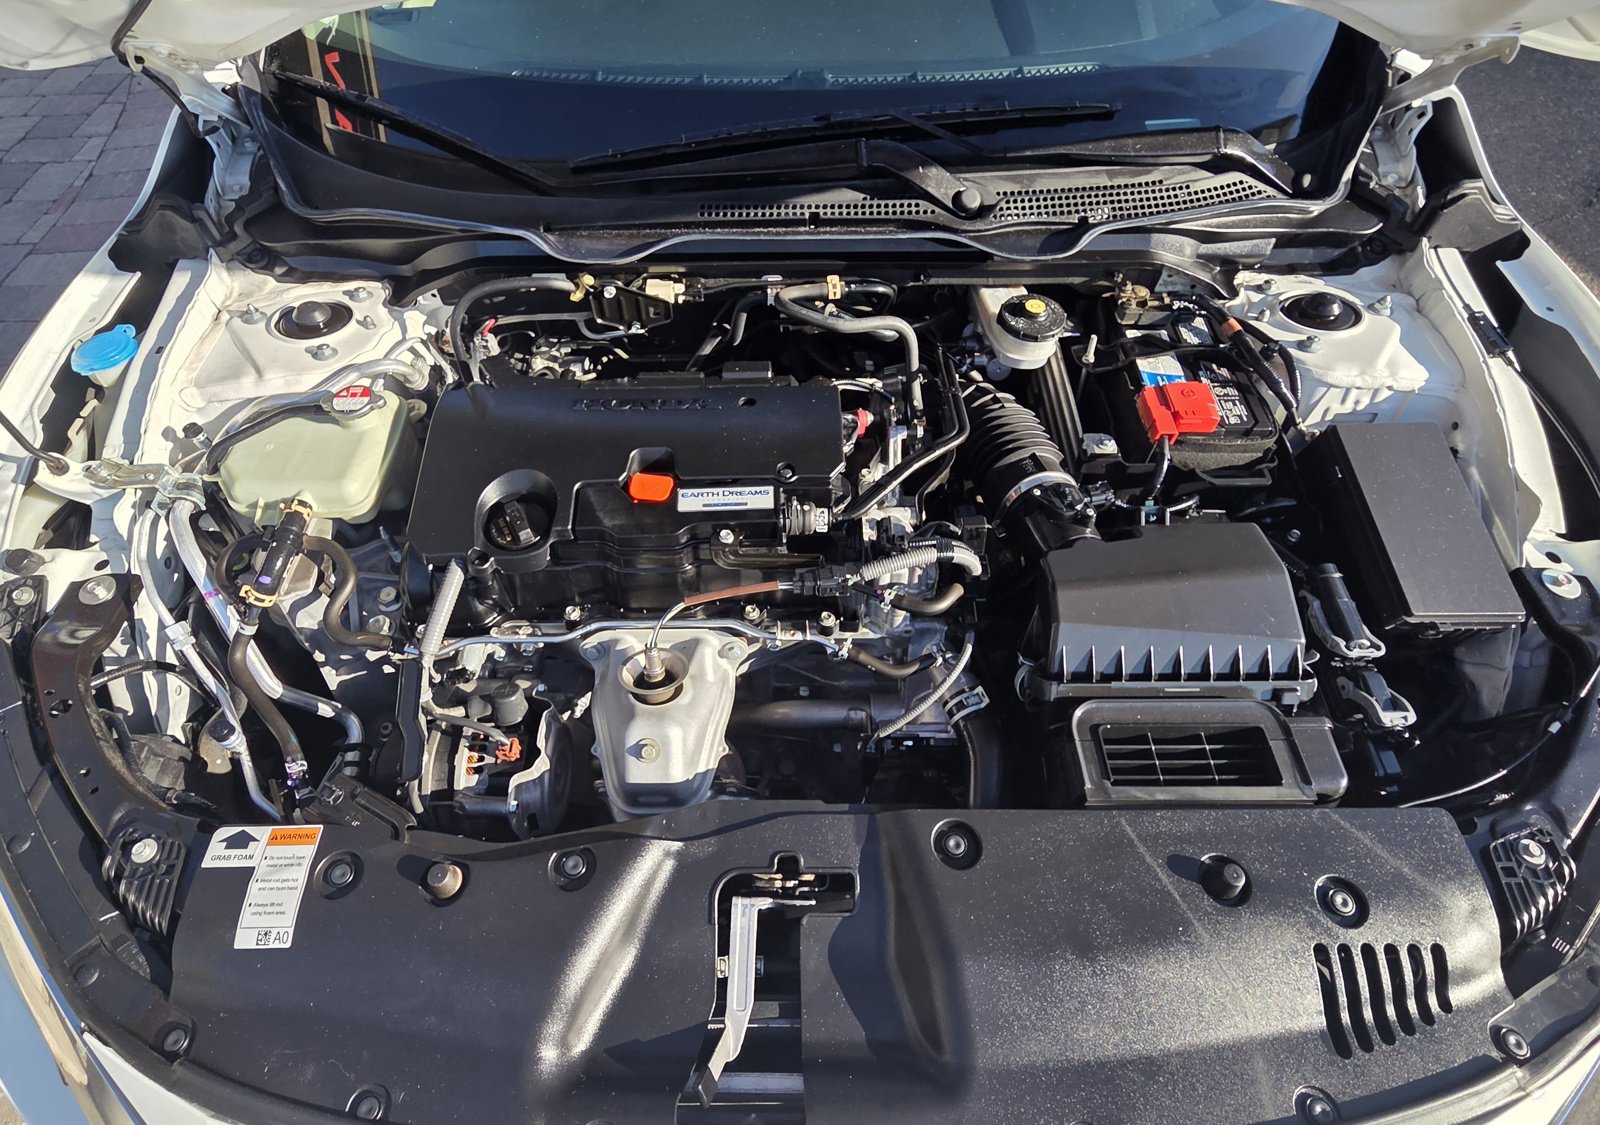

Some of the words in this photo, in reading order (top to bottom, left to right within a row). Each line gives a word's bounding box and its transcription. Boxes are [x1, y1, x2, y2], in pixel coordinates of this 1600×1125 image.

[570, 398, 722, 412] HONDA
[722, 489, 770, 497] DREAMS
[279, 832, 316, 840] WARNING
[272, 931, 290, 945] A0
